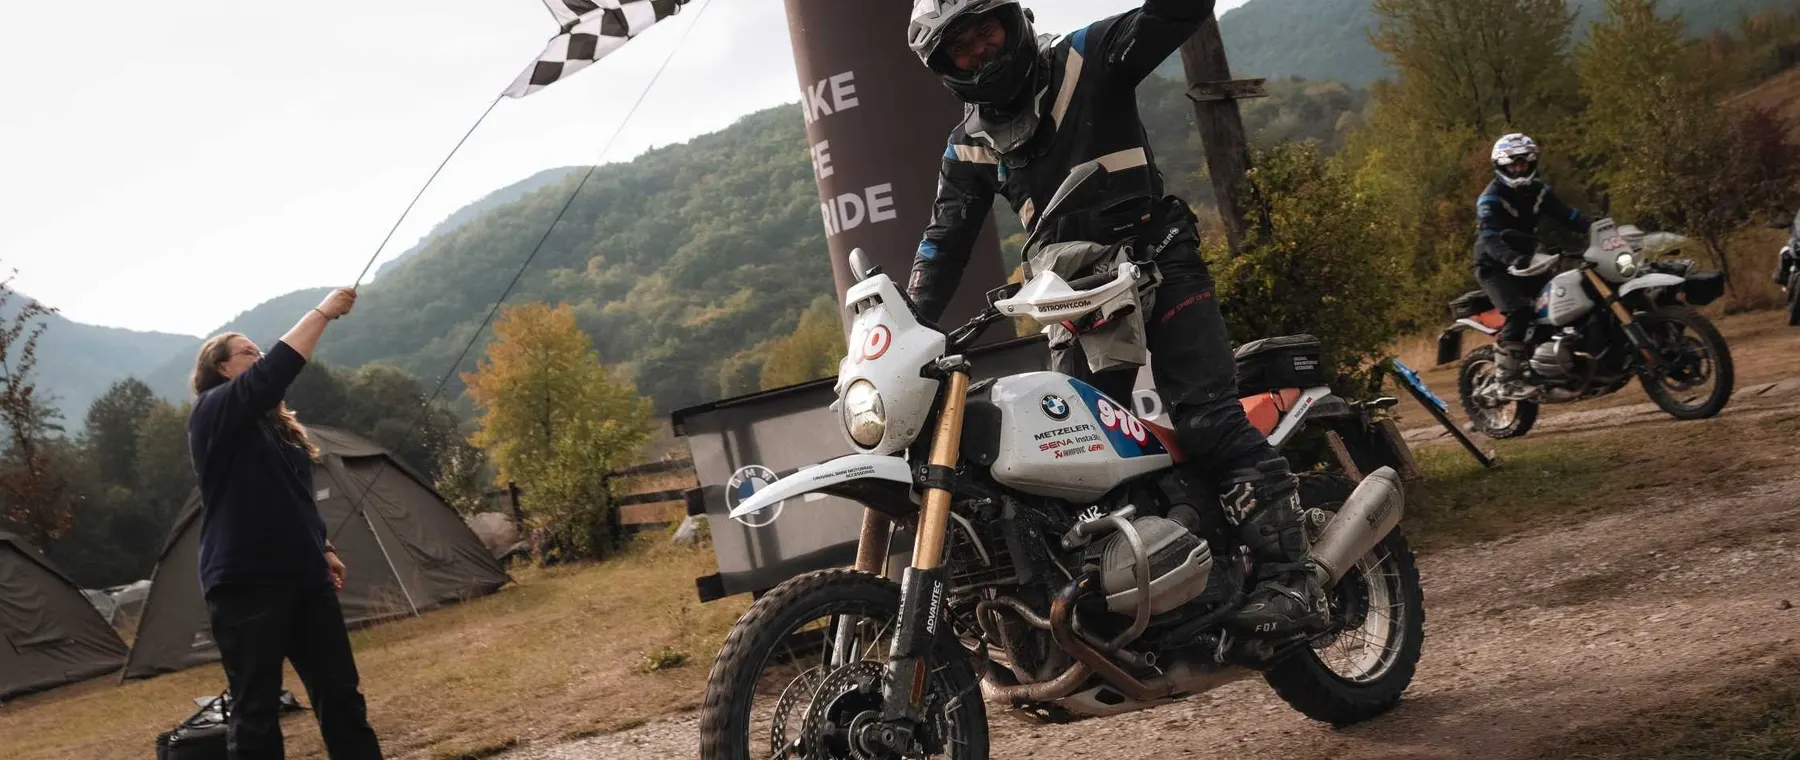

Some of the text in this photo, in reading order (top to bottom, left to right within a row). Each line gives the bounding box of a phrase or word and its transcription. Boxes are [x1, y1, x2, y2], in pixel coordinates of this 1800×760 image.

[820, 182, 897, 239] RIDE
[1037, 300, 1092, 312] GSTROPHY.COM
[1097, 398, 1148, 446] 910
[1034, 424, 1090, 441] METZELER
[1039, 438, 1074, 452] SENA
[926, 580, 941, 634] ADVANTEC
[1255, 621, 1277, 632] FOX
